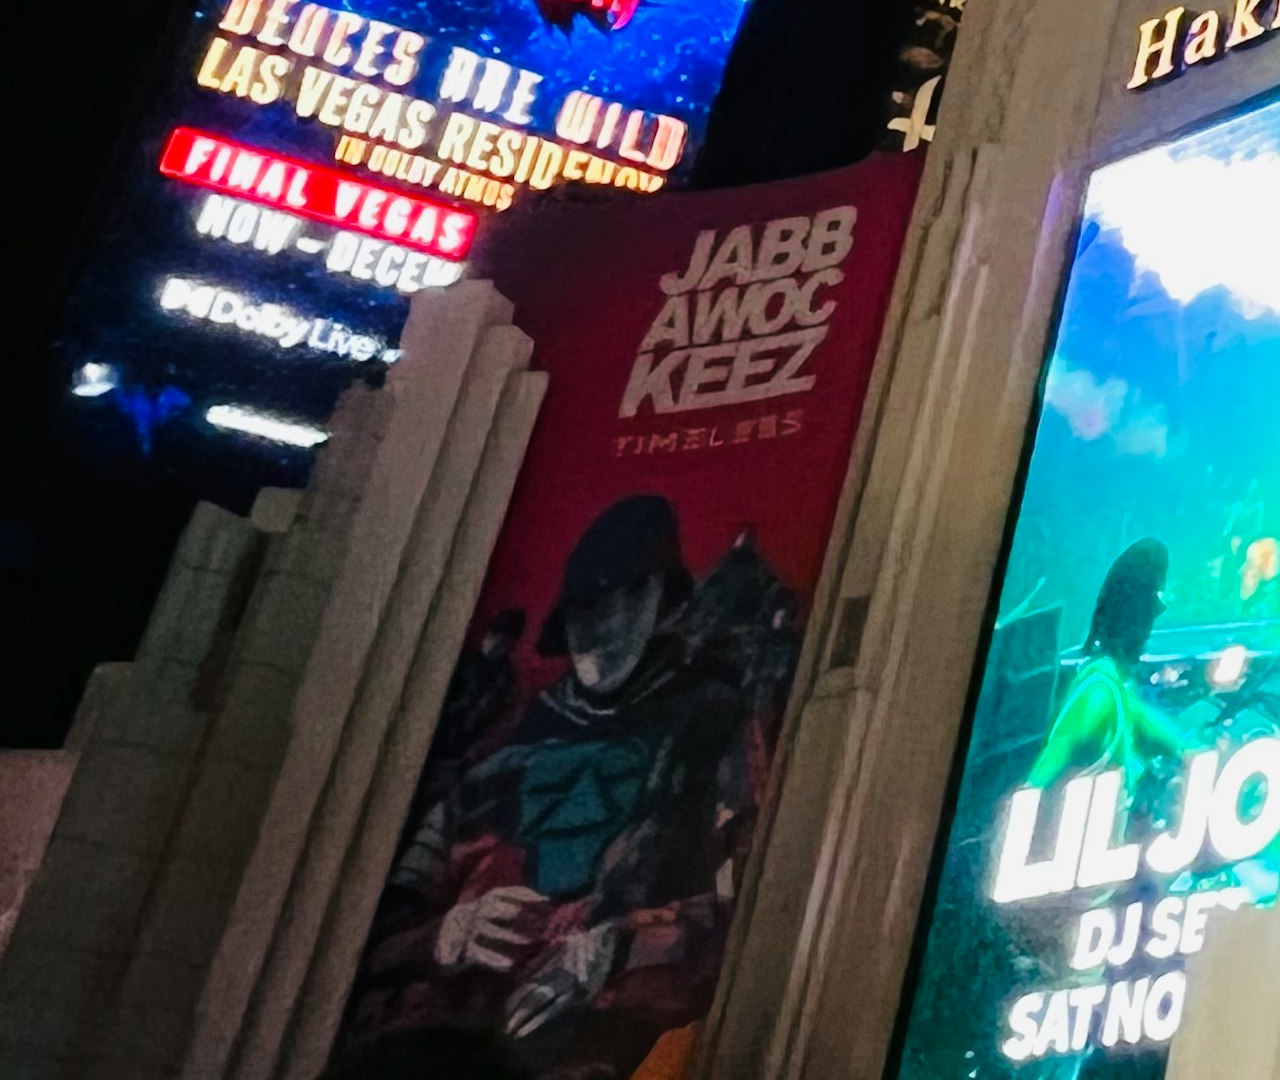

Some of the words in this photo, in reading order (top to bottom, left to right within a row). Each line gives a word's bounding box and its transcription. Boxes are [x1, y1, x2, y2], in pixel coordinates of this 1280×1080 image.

[197, 35, 291, 106] LAS
[298, 66, 433, 165] VEGAS
[440, 44, 544, 126] ARE
[556, 89, 688, 171] WILD
[185, 132, 307, 208] FINAL
[333, 181, 467, 253] VEGAS
[658, 204, 858, 296] JABB
[208, 289, 310, 348] Dolby
[307, 316, 378, 362] Live
[637, 267, 846, 355] AWOC
[617, 324, 831, 419] KEEZ
[991, 768, 1140, 903] LIL
[1070, 901, 1143, 970] DJ
[1001, 984, 1107, 1061] SAT
